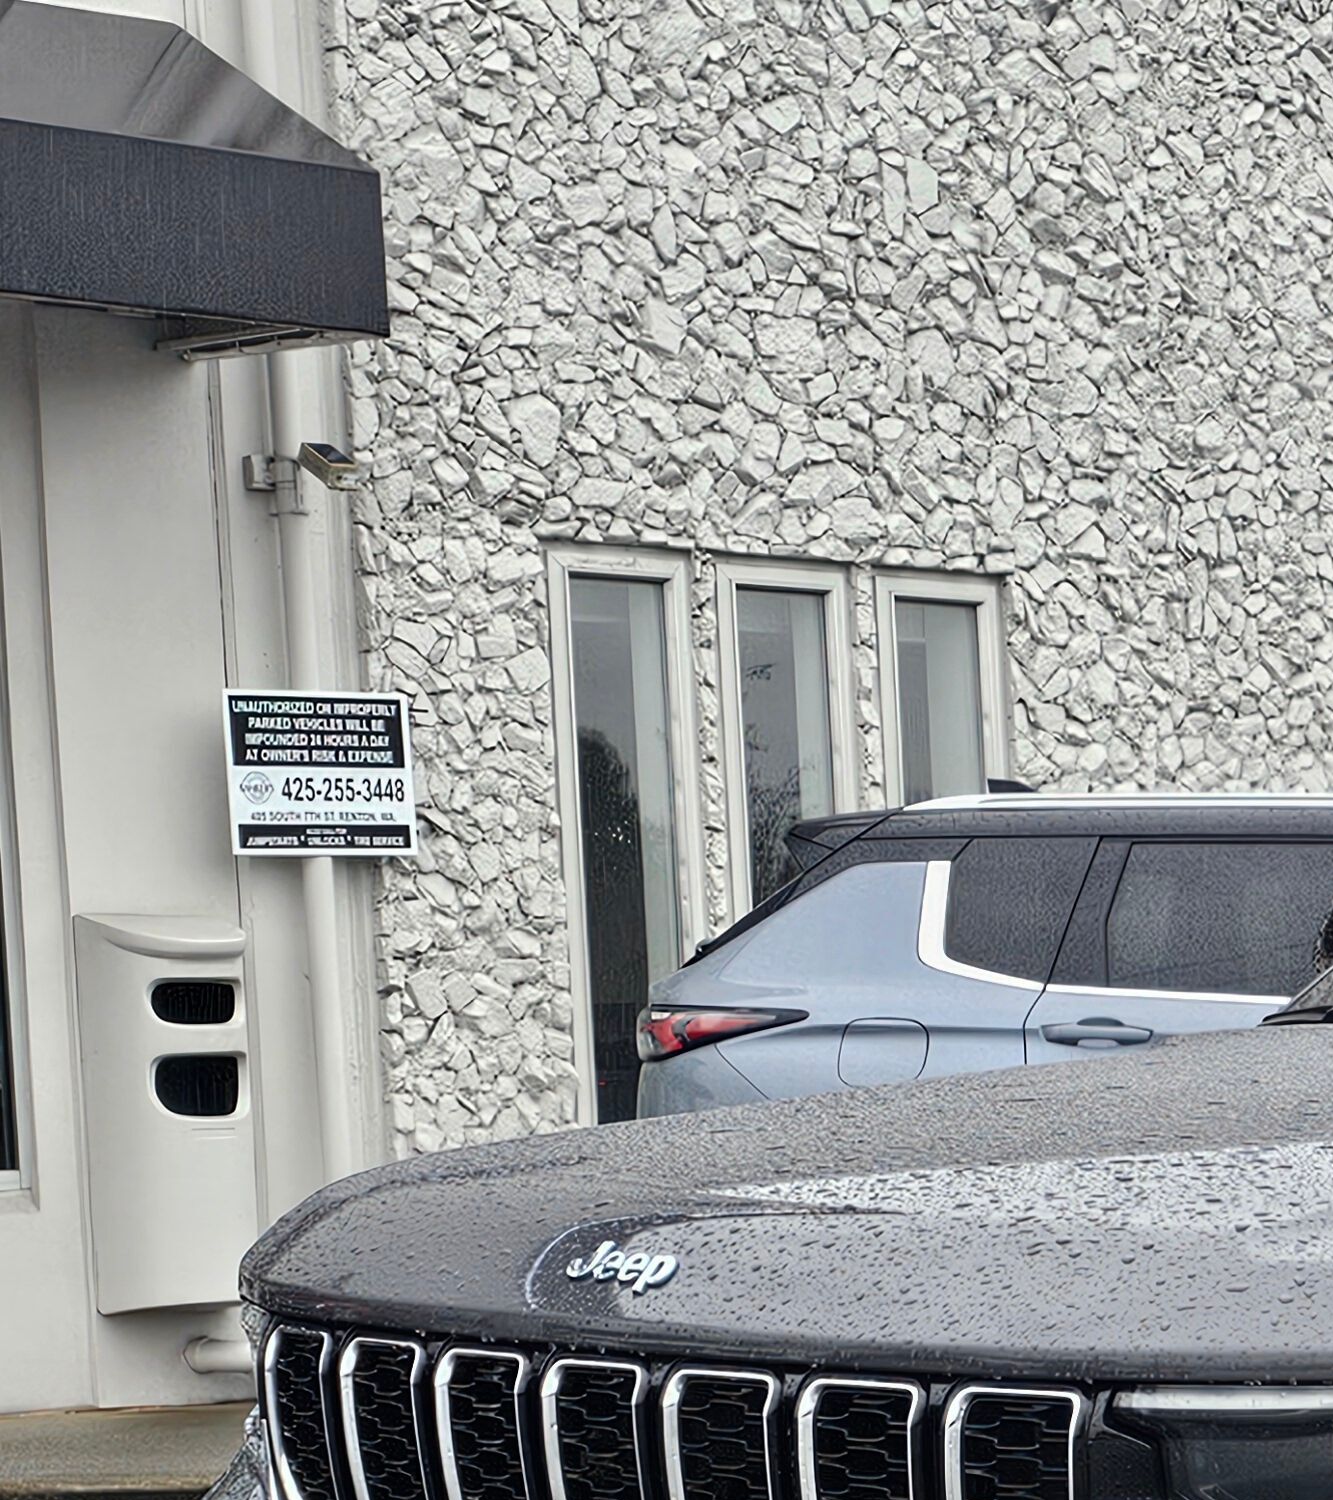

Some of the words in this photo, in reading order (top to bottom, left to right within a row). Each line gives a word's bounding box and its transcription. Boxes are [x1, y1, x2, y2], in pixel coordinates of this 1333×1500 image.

[345, 719, 370, 731] WILL
[324, 734, 359, 747] HOURS
[361, 735, 369, 747] A
[370, 735, 389, 747] DAY
[281, 777, 405, 802] 425-255-3448
[566, 1240, 679, 1295] Jeep
